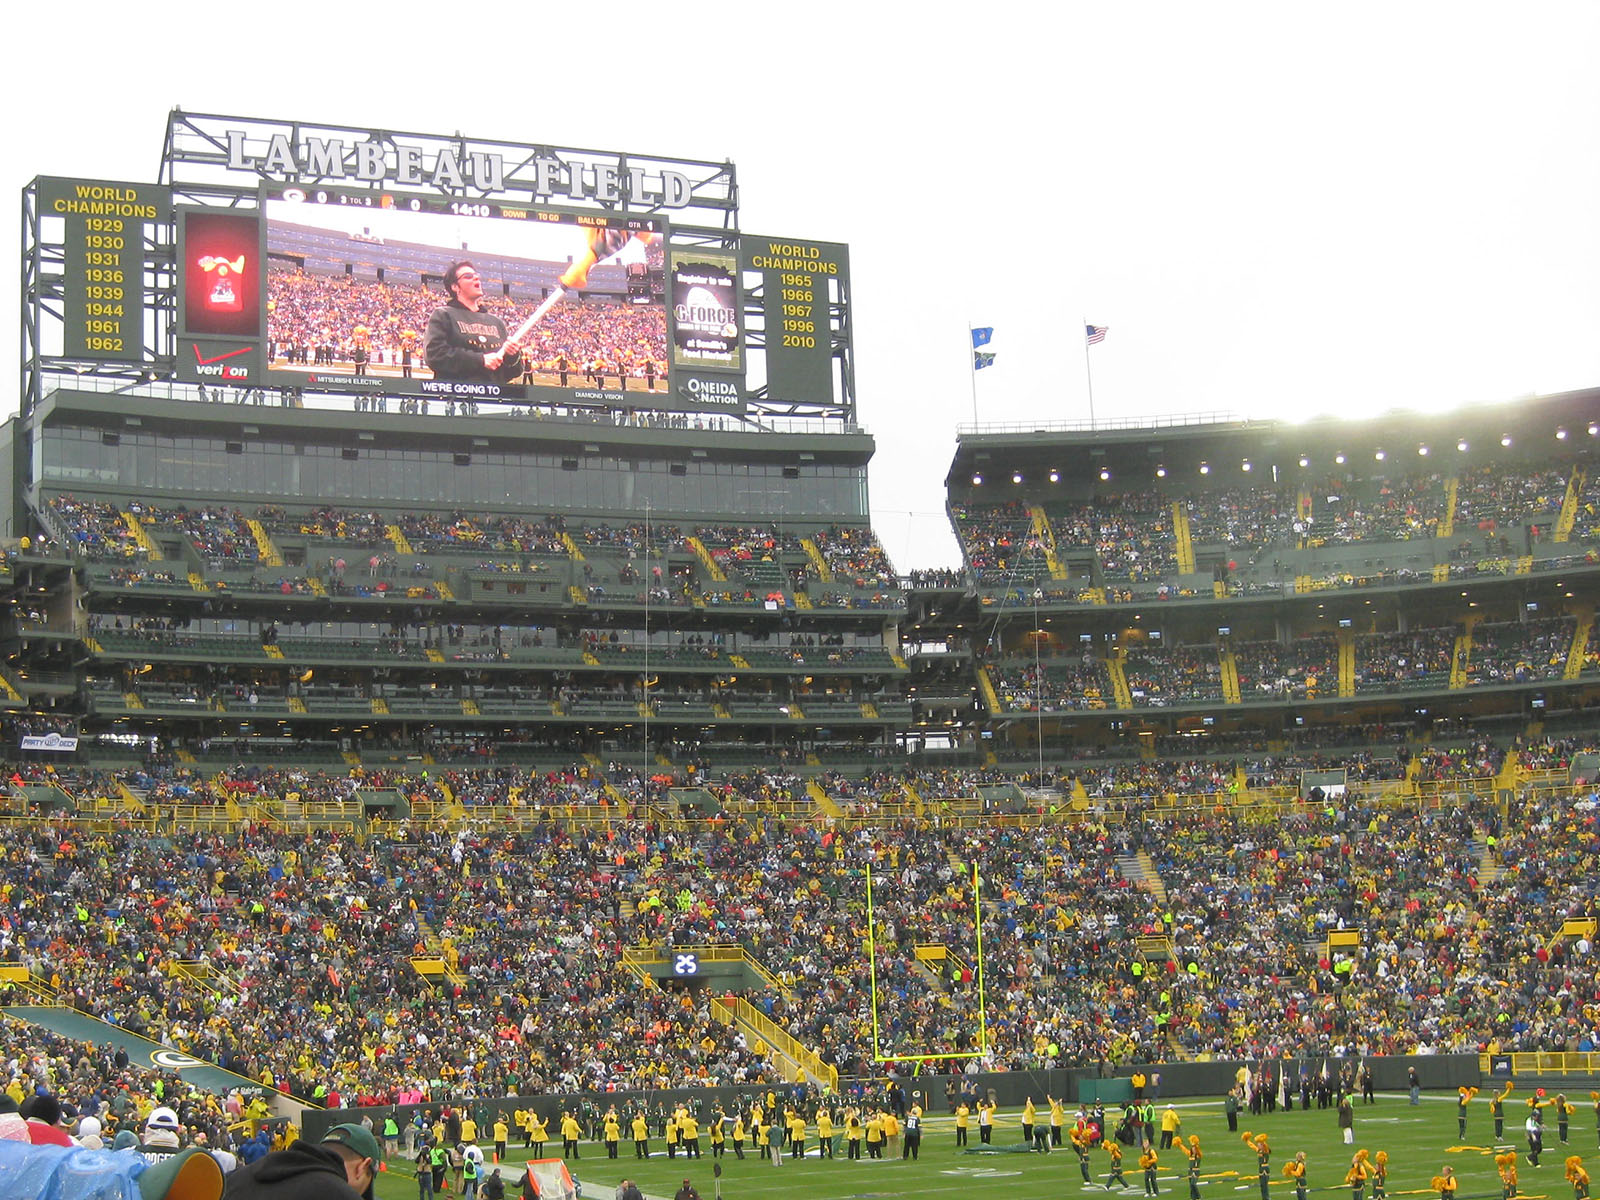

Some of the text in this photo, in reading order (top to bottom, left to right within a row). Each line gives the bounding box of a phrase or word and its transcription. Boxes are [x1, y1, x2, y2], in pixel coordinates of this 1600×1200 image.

[226, 130, 693, 209] LAMBEAU FIELD
[75, 185, 137, 202] WORLD
[53, 199, 157, 218] CHAMPIONS
[451, 203, 490, 217] 14:10
[502, 210, 527, 219] DOWN
[538, 213, 560, 222] TO GO
[577, 217, 607, 226] BALL ON
[86, 219, 124, 233] 1929
[86, 235, 124, 249] 1930
[769, 243, 820, 259] WORLD
[86, 252, 120, 266] 1931
[752, 256, 838, 274] CHAMPIONS
[86, 269, 124, 283] 1936
[781, 274, 813, 288] 1965
[86, 286, 124, 300] 1939
[781, 289, 814, 302] 1966
[86, 303, 124, 317] 1944
[782, 304, 812, 317] 1967
[86, 320, 121, 333] 1961
[783, 320, 815, 333] 1996
[86, 337, 123, 351] 1962
[783, 335, 815, 348] 2010
[195, 364, 248, 380] verizon
[317, 376, 383, 386] MITSUBISHI ELECTRIC
[688, 378, 738, 396] ONEIDA
[422, 382, 501, 395] WE'RE GOING TO
[701, 392, 738, 405] NATION
[59, 740, 76, 748] DECK
[675, 954, 697, 974] 25
